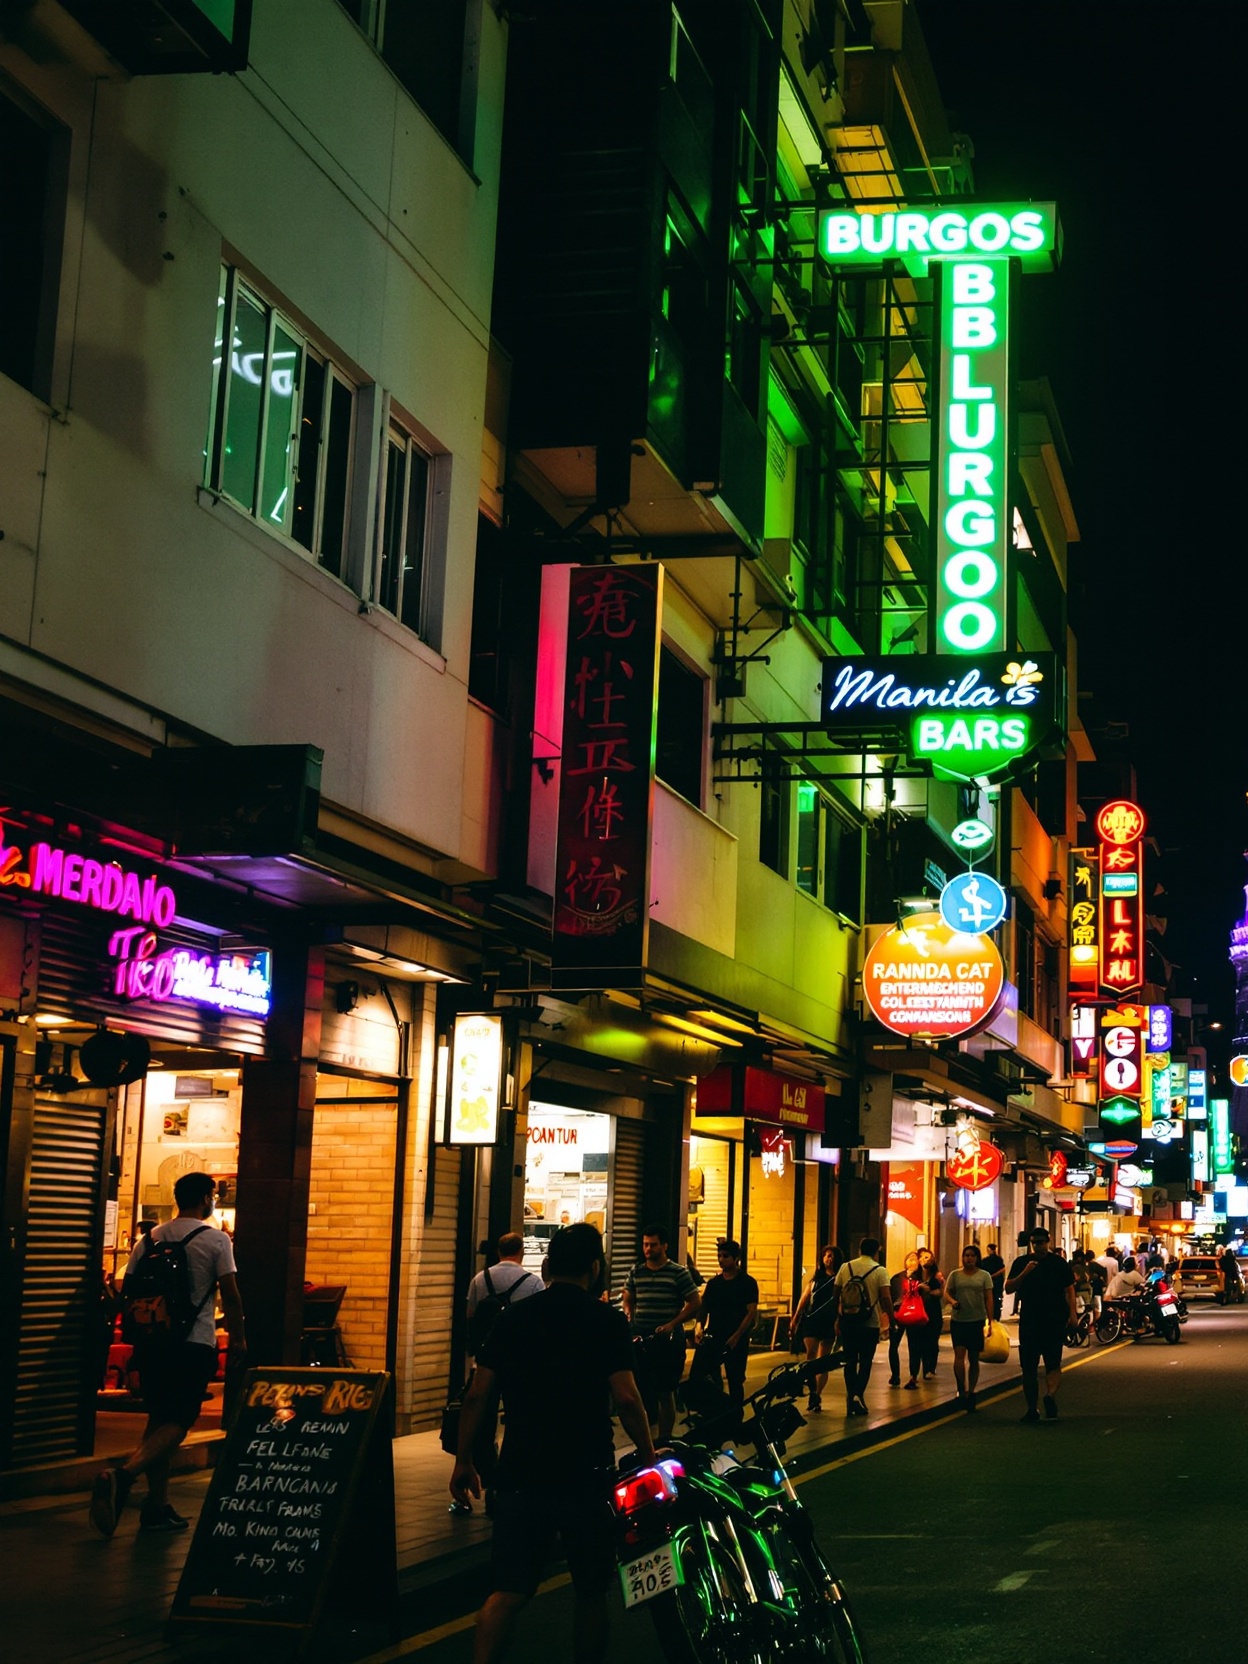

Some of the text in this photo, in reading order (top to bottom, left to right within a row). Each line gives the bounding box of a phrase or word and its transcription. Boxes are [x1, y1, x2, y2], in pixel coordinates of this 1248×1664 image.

[827, 211, 1046, 254] BURGOS
[943, 263, 999, 651] BBLURGOO
[918, 718, 1026, 751] BARS
[873, 962, 993, 979] RANNDA CAT
